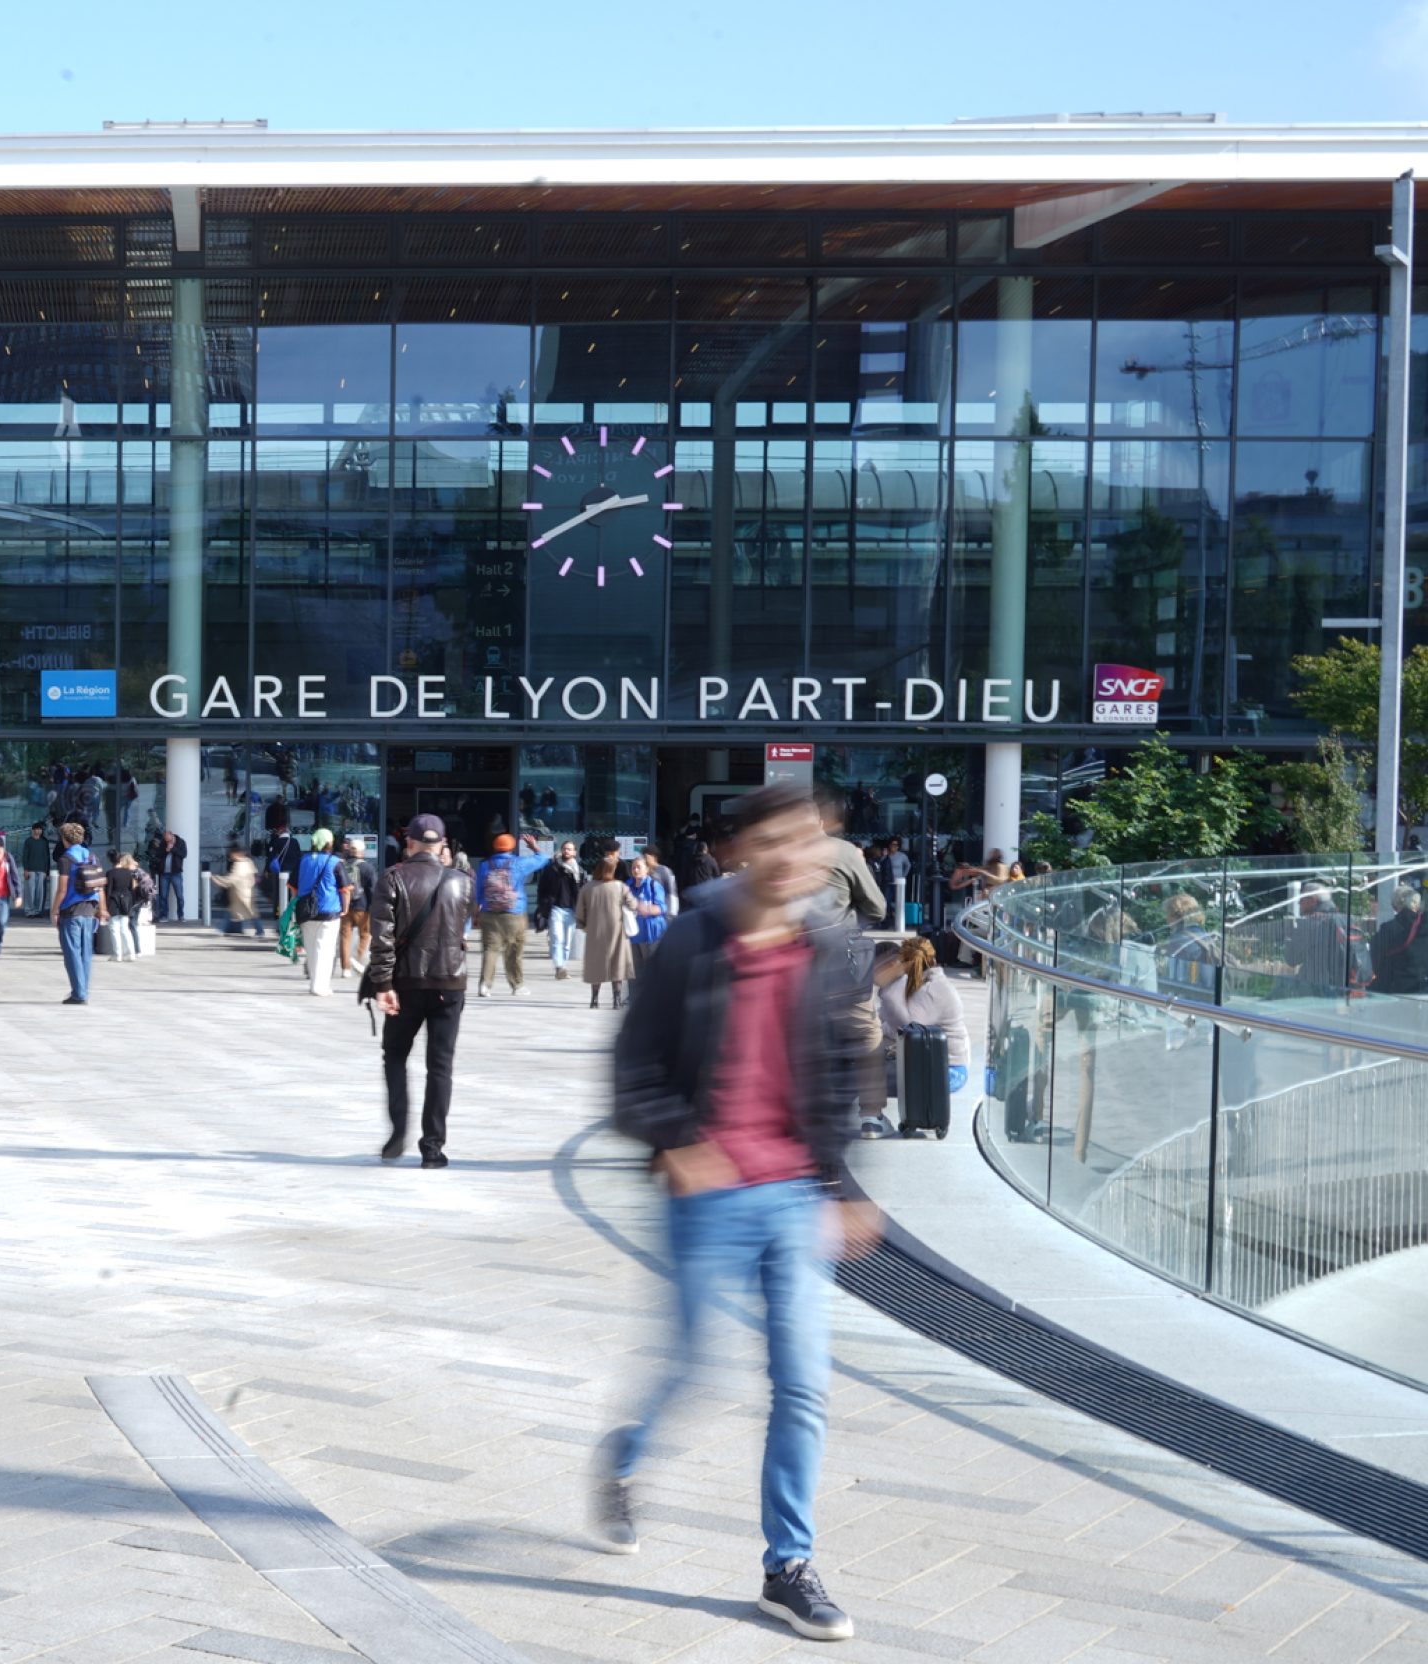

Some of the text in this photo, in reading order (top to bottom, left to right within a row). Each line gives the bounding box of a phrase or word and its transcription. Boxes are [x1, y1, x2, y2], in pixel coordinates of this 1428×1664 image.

[476, 562, 513, 576] Hall 2
[476, 624, 512, 637] Hall 1
[63, 685, 110, 696] La Région
[1098, 678, 1161, 697] SNCF
[149, 674, 1061, 723] GARE DE LYON PART-DIEU
[1095, 703, 1156, 715] GARES
